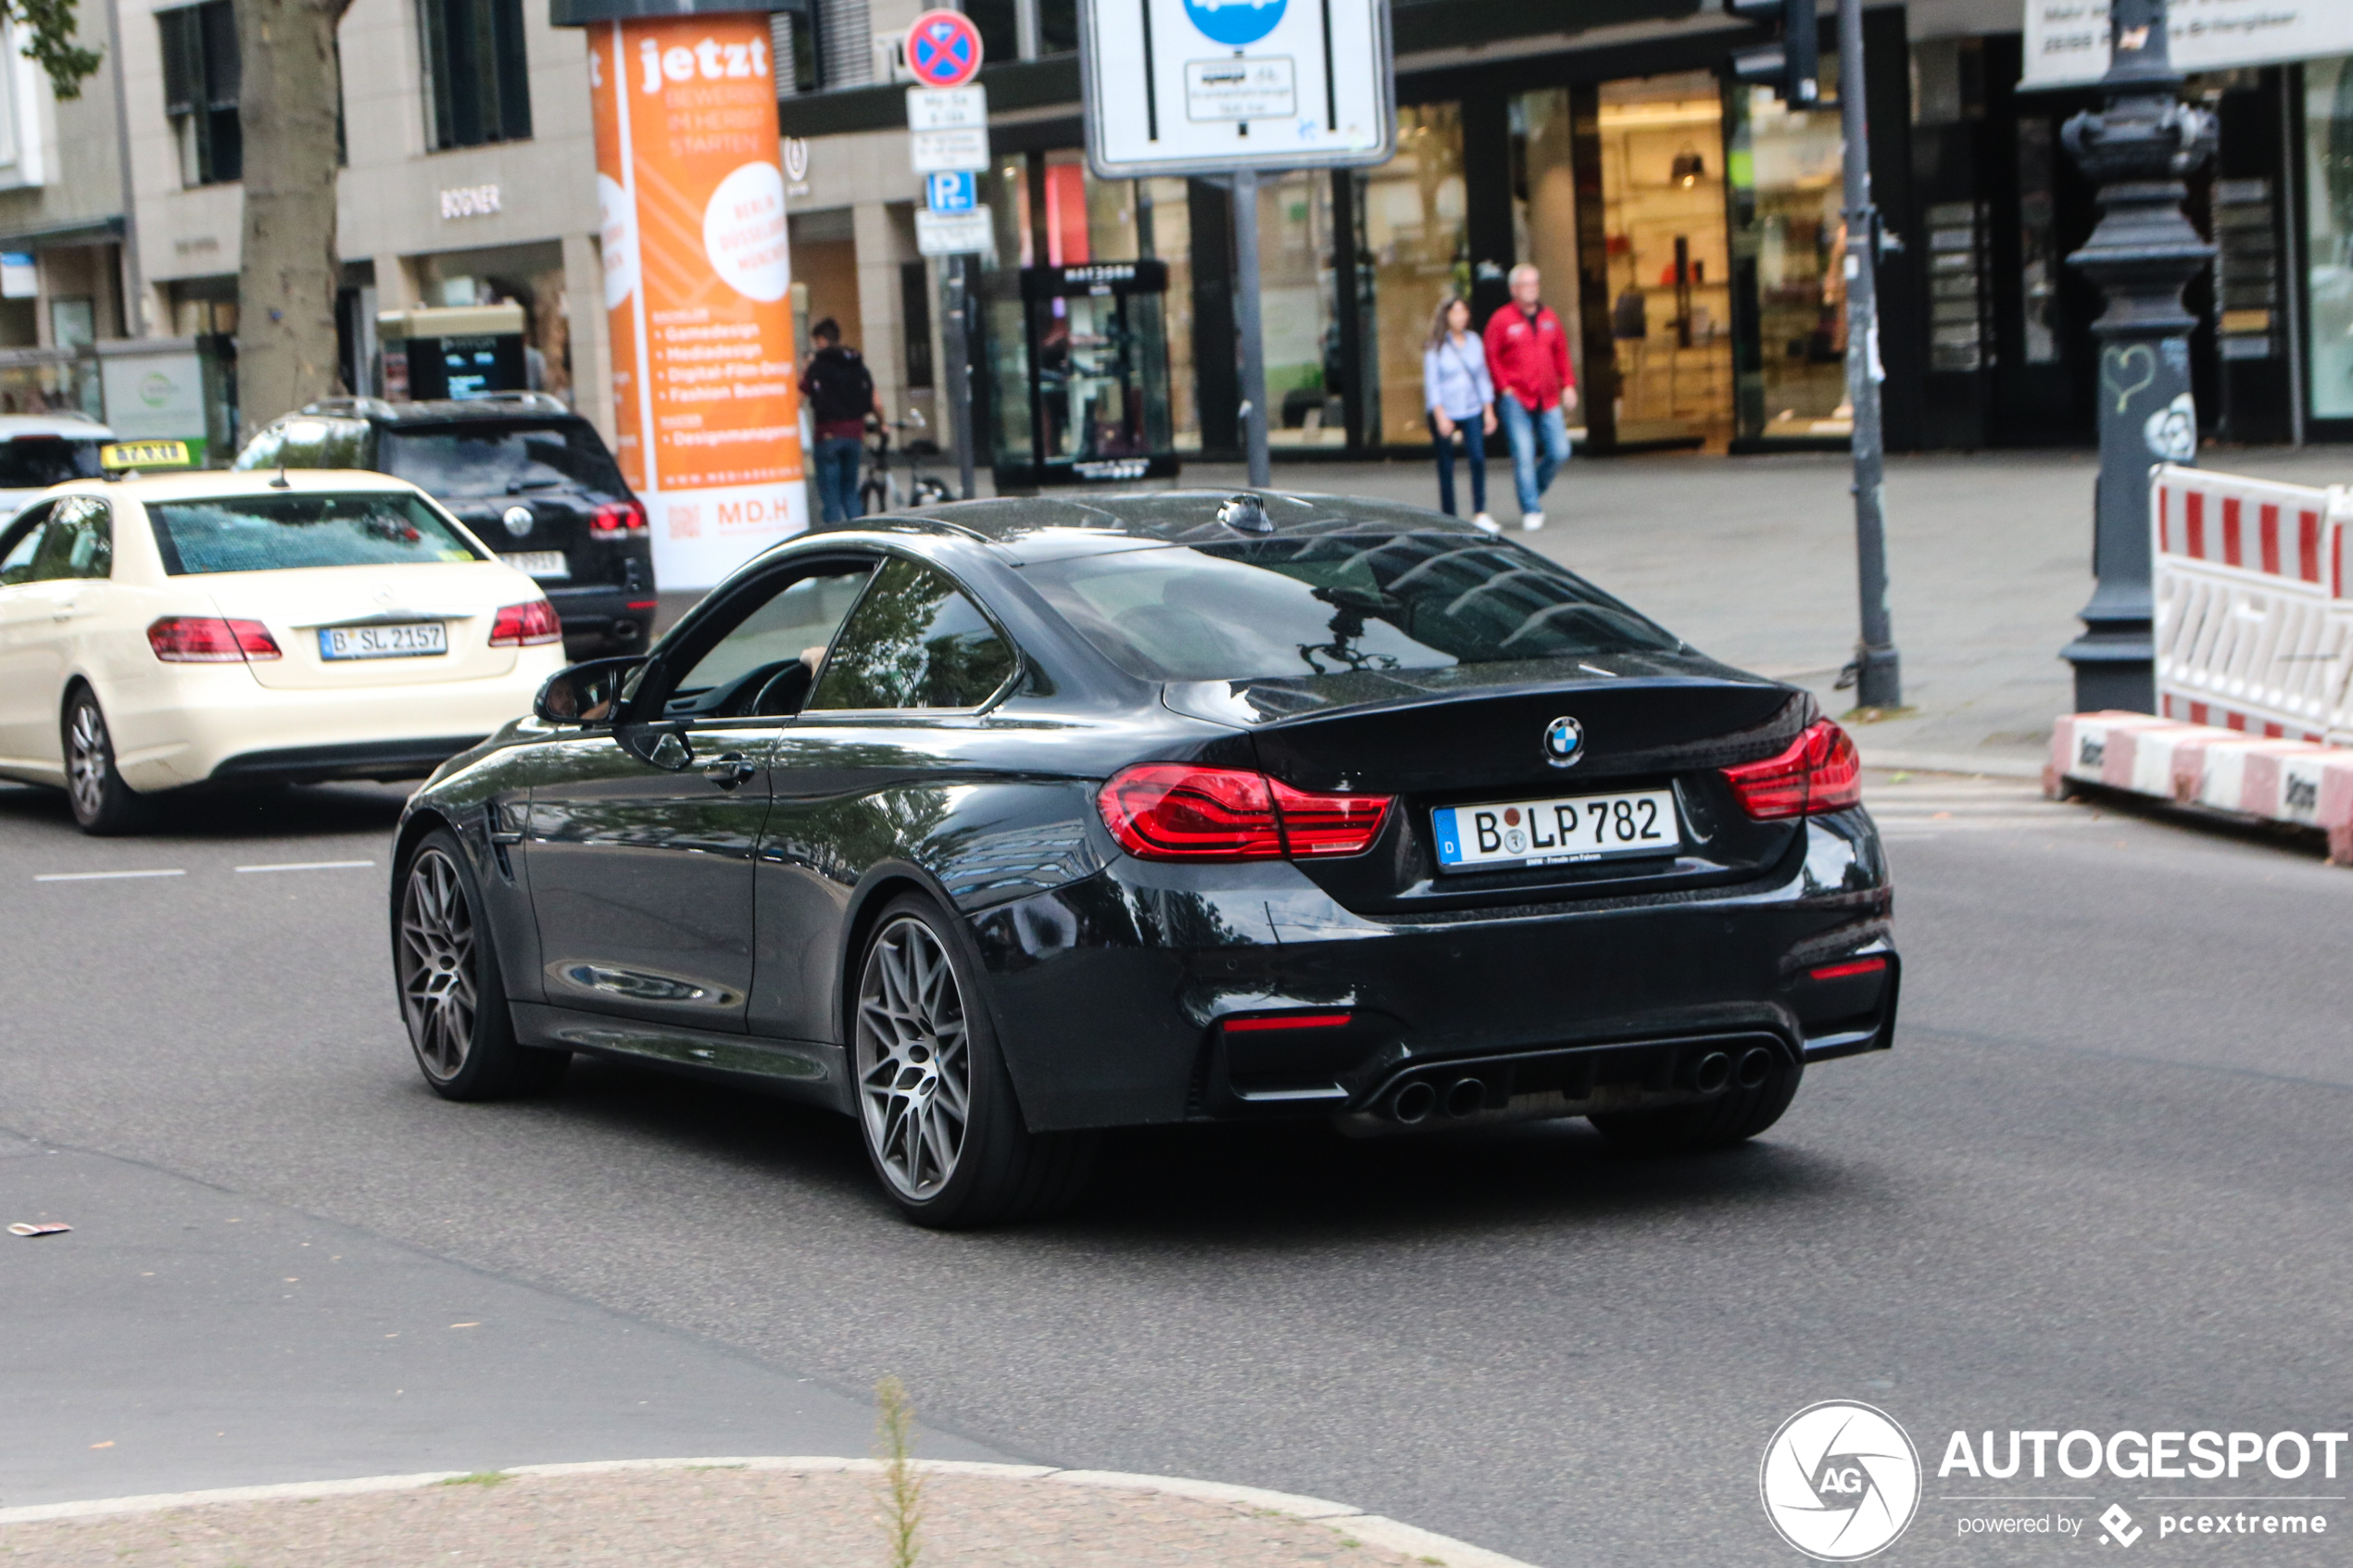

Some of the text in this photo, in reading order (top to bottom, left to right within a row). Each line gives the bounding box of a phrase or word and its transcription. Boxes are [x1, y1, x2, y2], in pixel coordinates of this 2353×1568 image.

[639, 34, 768, 94] jetzt
[441, 184, 500, 219] BOGNER
[934, 173, 962, 207] P
[664, 322, 761, 342] Gamedesign
[665, 344, 762, 362] Mediadesign
[669, 384, 731, 403] Fashion
[120, 444, 174, 463] TAXI
[717, 497, 790, 525] MD.H
[333, 625, 440, 652] B SL 2157
[1475, 798, 1662, 853] B LP 782
[1444, 840, 1454, 854] D
